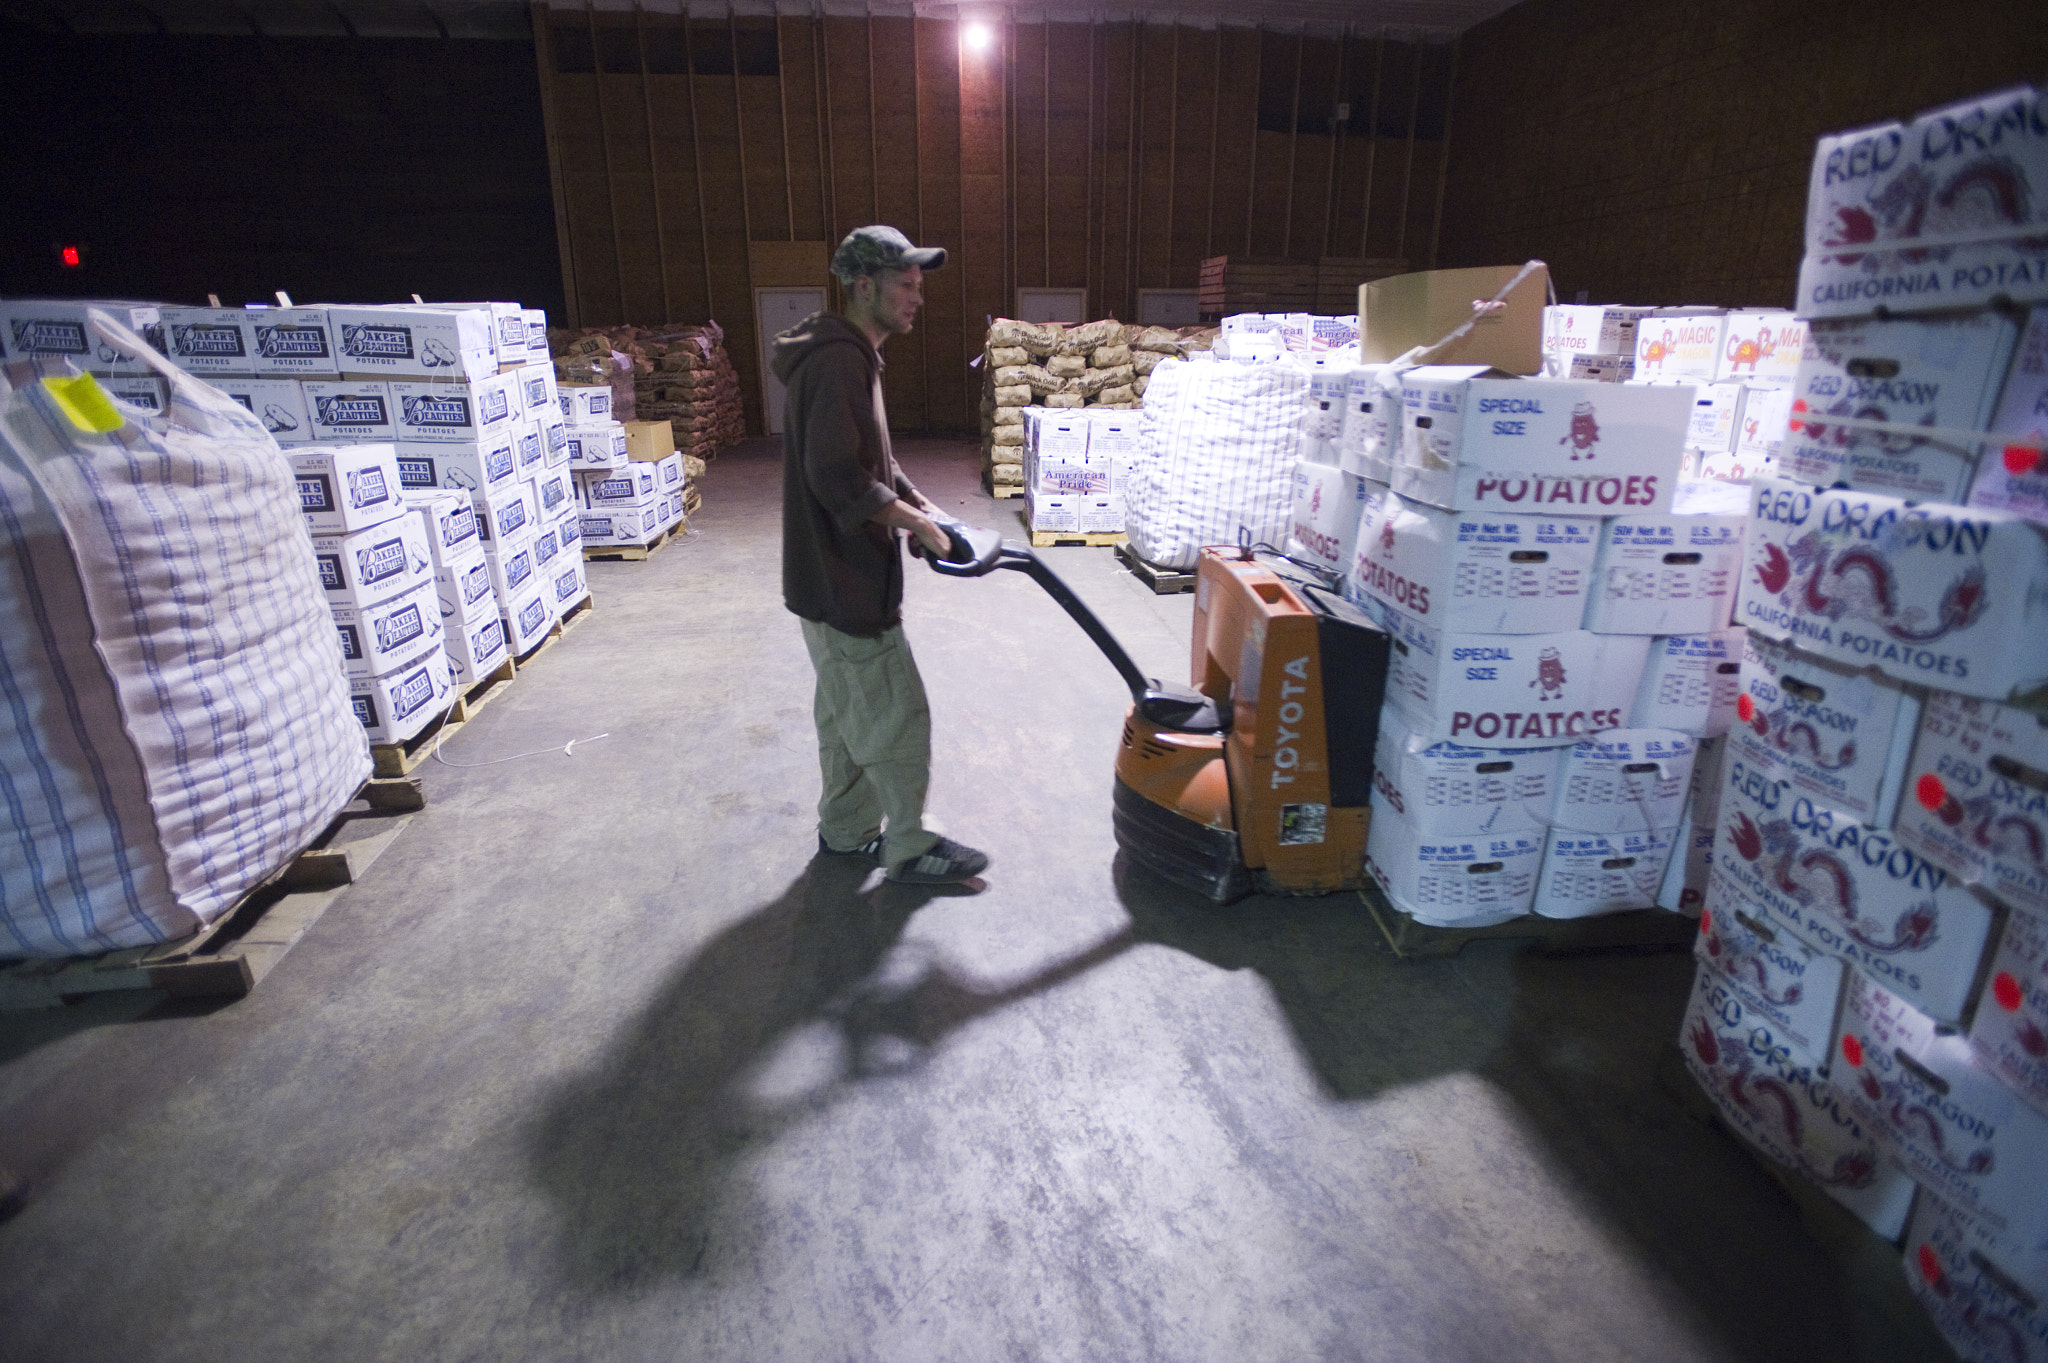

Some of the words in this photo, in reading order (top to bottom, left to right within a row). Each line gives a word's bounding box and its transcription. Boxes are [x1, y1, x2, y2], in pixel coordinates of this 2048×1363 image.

[1825, 131, 1902, 188] RED
[1813, 270, 1941, 304] CALIFORNIA
[1021, 330, 1038, 340] Black
[1678, 326, 1716, 345] MAGIC
[1020, 338, 1052, 348] Potatoes
[1077, 339, 1092, 347] Black
[1547, 336, 1588, 349] POATOES
[1676, 347, 1712, 360] DRAGON
[190, 358, 230, 366] POTATOES
[1025, 374, 1042, 384] Black
[1043, 378, 1058, 387] Gold
[1087, 378, 1103, 387] Black
[1104, 373, 1118, 382] Gold
[1808, 376, 1843, 397] RED
[1478, 398, 1544, 414] SPECIAL
[1493, 420, 1528, 436] SIZE
[1851, 453, 1921, 475] POTATOES
[1045, 470, 1106, 480] American
[1060, 480, 1093, 488] Pride
[1475, 474, 1658, 506] POTATOES
[361, 505, 384, 516] POTATOES
[1756, 488, 1812, 526] RED
[1460, 522, 1478, 534] 50#
[1482, 523, 1500, 534] Net
[1537, 524, 1556, 534] U.S.
[1565, 525, 1580, 535] No.
[1614, 526, 1632, 536] 50#
[1637, 526, 1655, 536] Net
[452, 540, 472, 552] POTATOES
[374, 577, 401, 592] POTATOES
[1668, 636, 1688, 648] 50#
[1746, 600, 1833, 645] CALIFORNIA
[1840, 631, 1970, 679] POTATOES
[390, 642, 417, 659] POTATOES
[1451, 647, 1514, 662] SPECIAL
[1466, 667, 1499, 681] SIZE
[1750, 678, 1778, 703] RED
[406, 706, 430, 724] POTATOES
[1271, 656, 1310, 790] TOYOTA
[1938, 754, 1982, 788] RED
[1420, 846, 1438, 854] 50#
[1490, 841, 1508, 852] U.S.
[1557, 840, 1574, 850] 50#
[1792, 797, 1947, 892] DRAGON
[1721, 854, 1801, 926] CALIFORNIA
[1808, 918, 1922, 991] POTATOES
